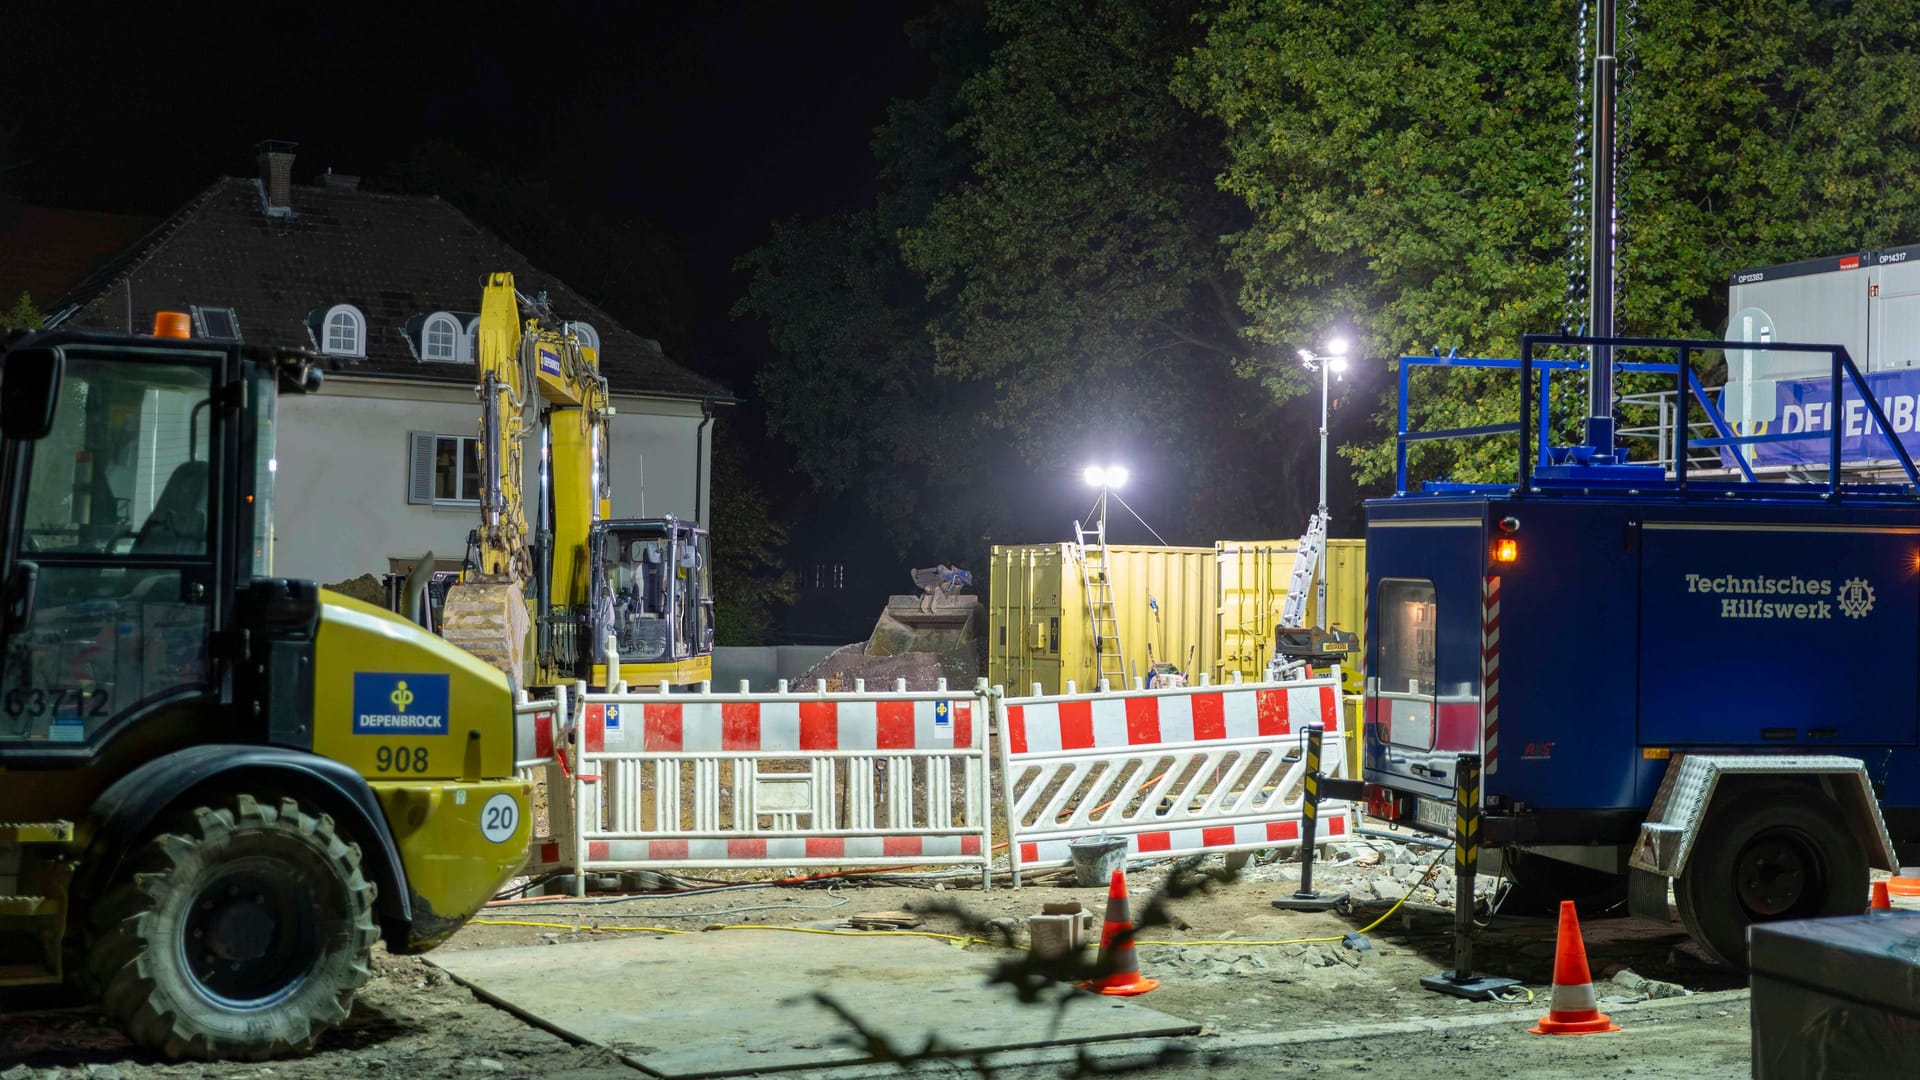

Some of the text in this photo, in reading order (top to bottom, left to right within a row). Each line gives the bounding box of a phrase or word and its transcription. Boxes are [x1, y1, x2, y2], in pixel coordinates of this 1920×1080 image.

[1781, 395, 1920, 437] DEPENB
[1685, 574, 1832, 595] Technisches
[1720, 599, 1832, 619] Hilfswerk
[5, 688, 109, 718] 63712
[360, 714, 442, 728] DEPENBROCK
[376, 745, 429, 773] 908
[487, 806, 513, 830] 20
